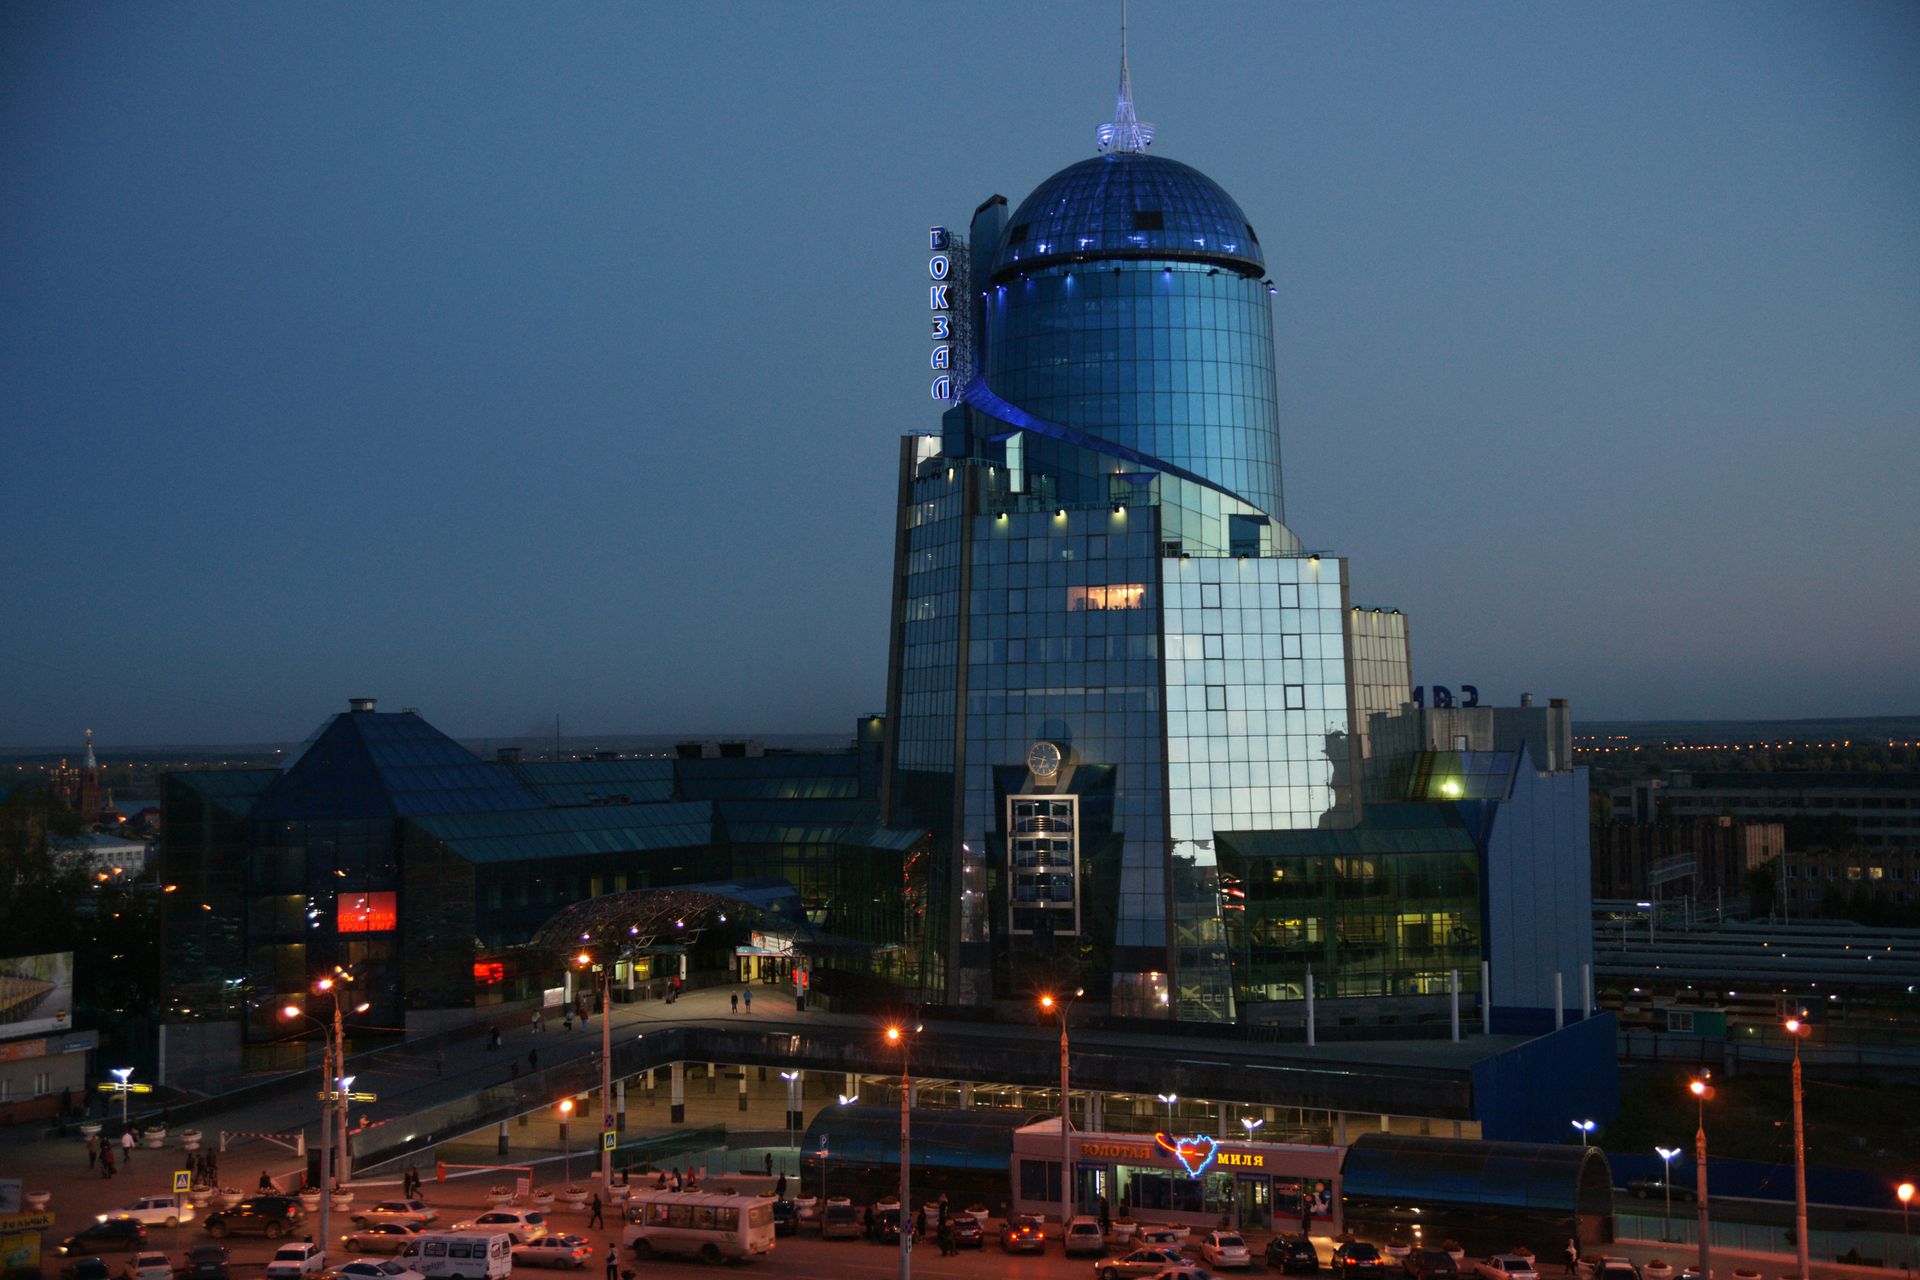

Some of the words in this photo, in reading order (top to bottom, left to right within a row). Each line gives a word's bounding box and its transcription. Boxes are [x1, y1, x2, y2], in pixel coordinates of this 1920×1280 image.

[929, 225, 950, 400] ВОКЗАЛ
[338, 912, 394, 922] ГОСНИЦА
[1081, 1143, 1151, 1160] ЗОЛОТАЯ
[1217, 1152, 1265, 1167] МИЛЯ
